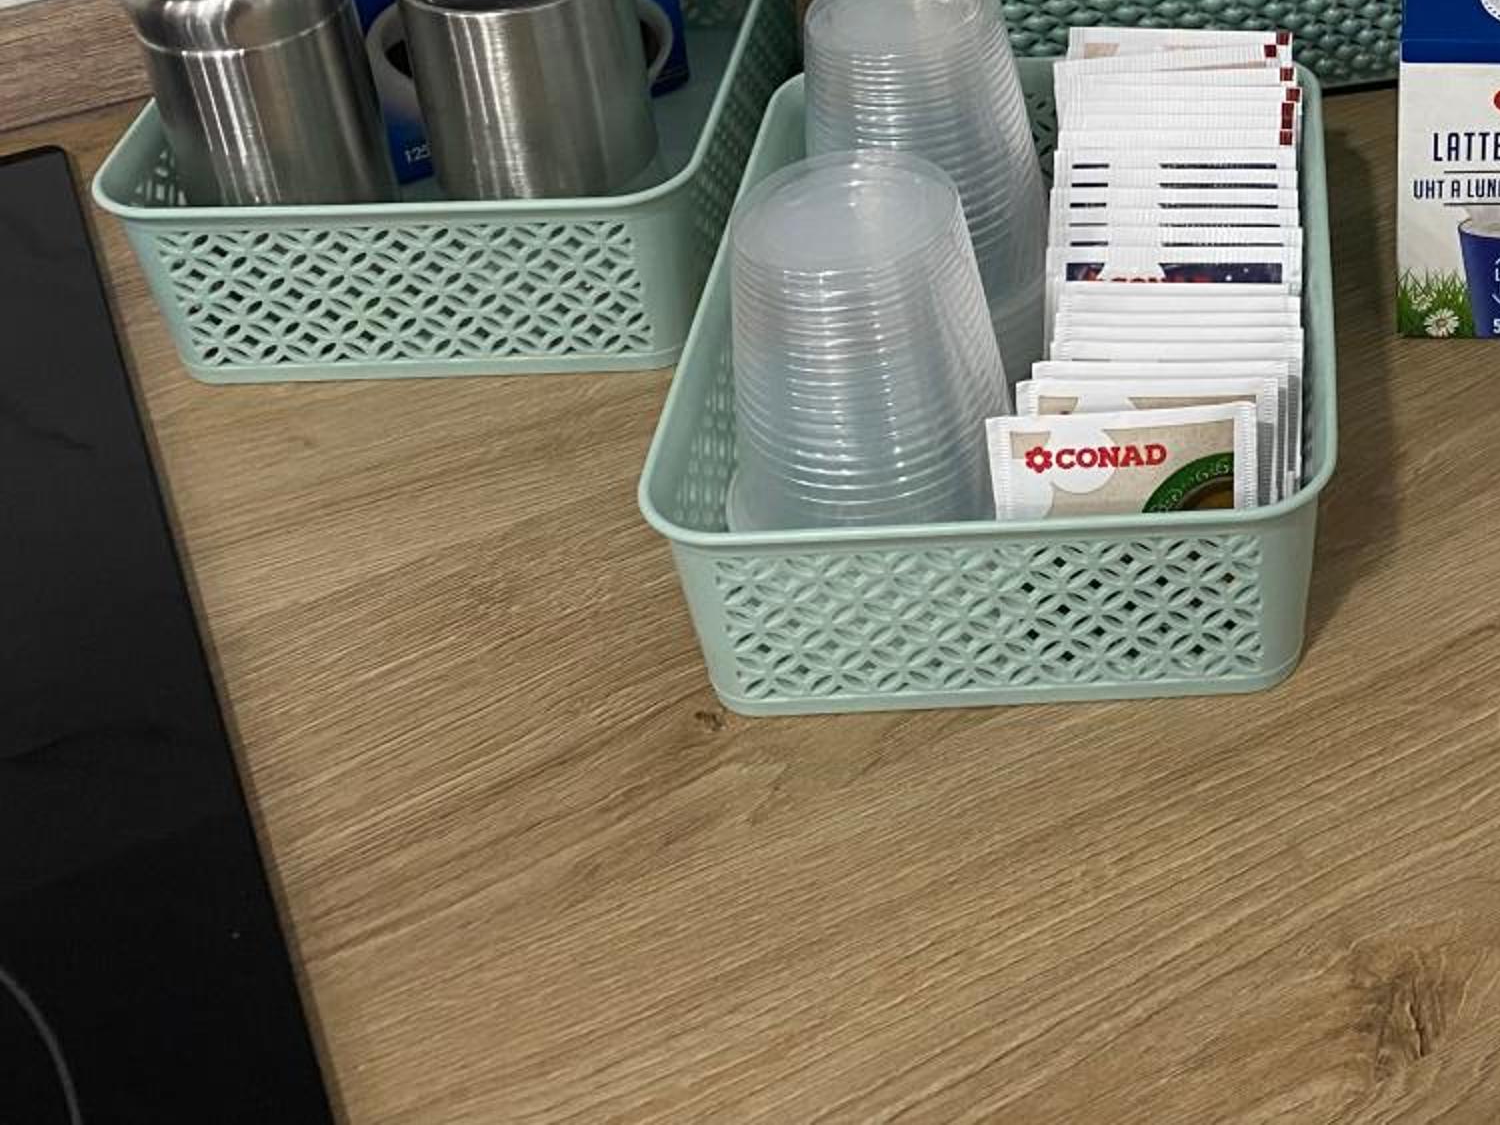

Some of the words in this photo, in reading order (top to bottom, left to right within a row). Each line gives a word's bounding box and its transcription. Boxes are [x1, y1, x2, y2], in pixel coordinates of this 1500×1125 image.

[1413, 180, 1444, 200] UHT
[1451, 179, 1461, 199] A
[1055, 443, 1168, 469] CONAD
